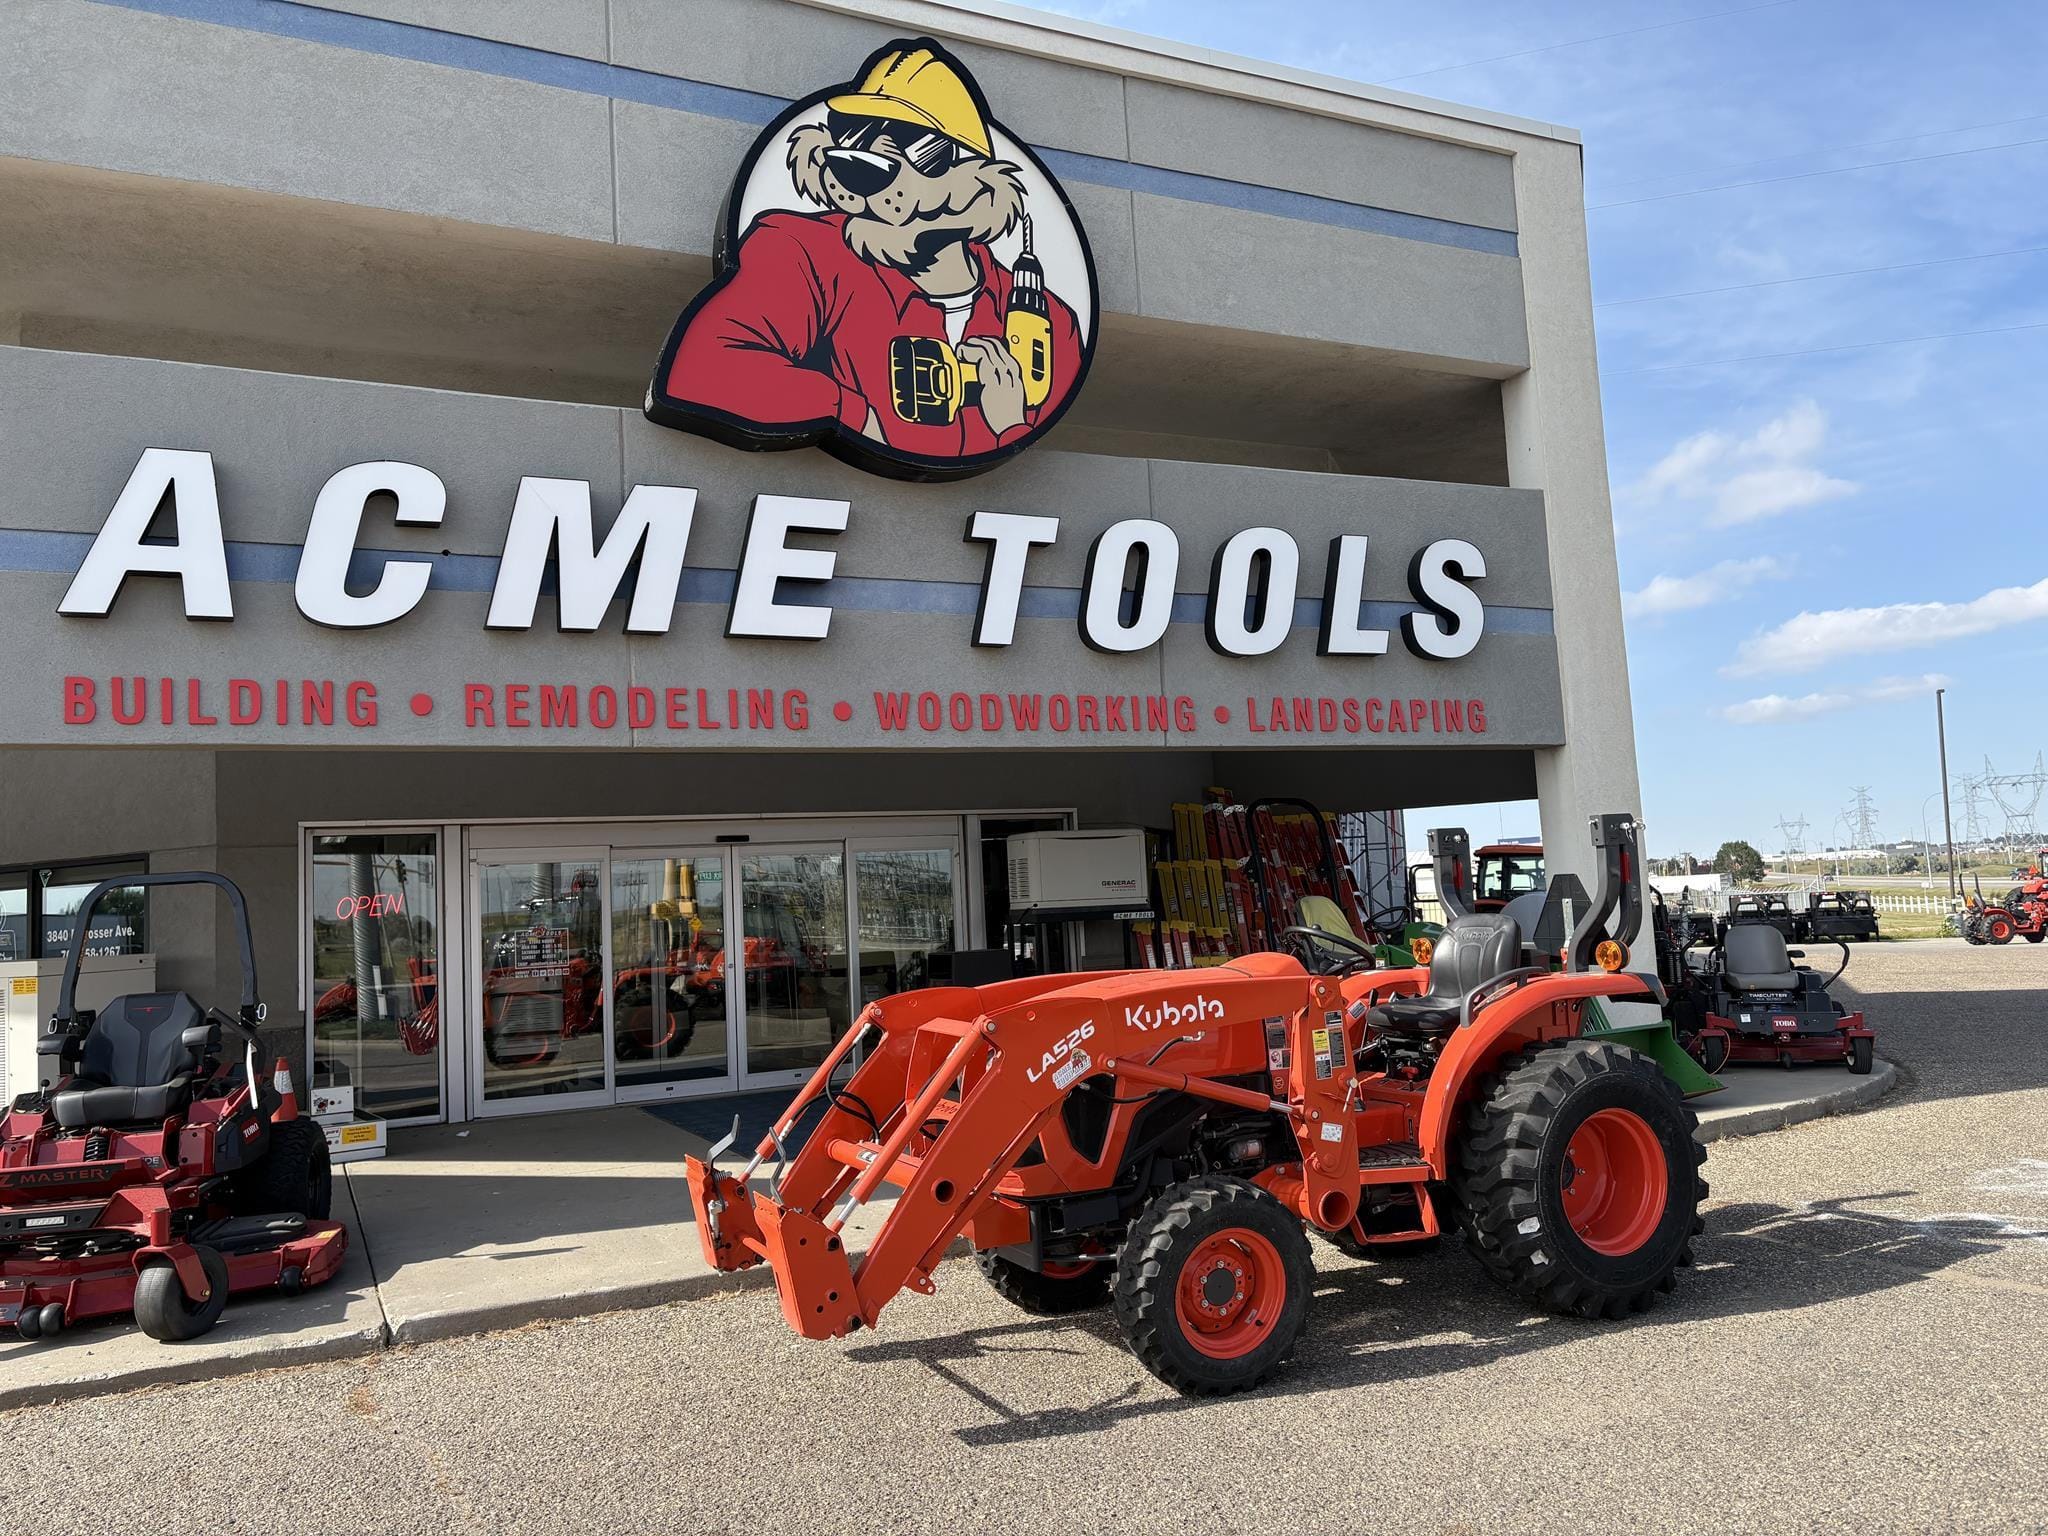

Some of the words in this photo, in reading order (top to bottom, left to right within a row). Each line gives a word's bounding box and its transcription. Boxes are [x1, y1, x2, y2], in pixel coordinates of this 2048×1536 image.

[56, 446, 851, 639] ACME
[963, 511, 1487, 660] TOOLS
[63, 675, 379, 727] BUILDING
[464, 683, 809, 731] REMODELING
[873, 691, 1197, 732] WOODWORKING
[1247, 696, 1487, 733] LANDSCAPING
[336, 893, 404, 920] OPEN
[47, 929, 69, 943] 3840
[88, 927, 113, 939] osser
[114, 924, 136, 938] Ave.
[1124, 994, 1225, 1032] Kubota
[1026, 1019, 1095, 1084] LA526
[243, 1122, 260, 1139] TORO
[20, 1168, 105, 1185] MASTER
